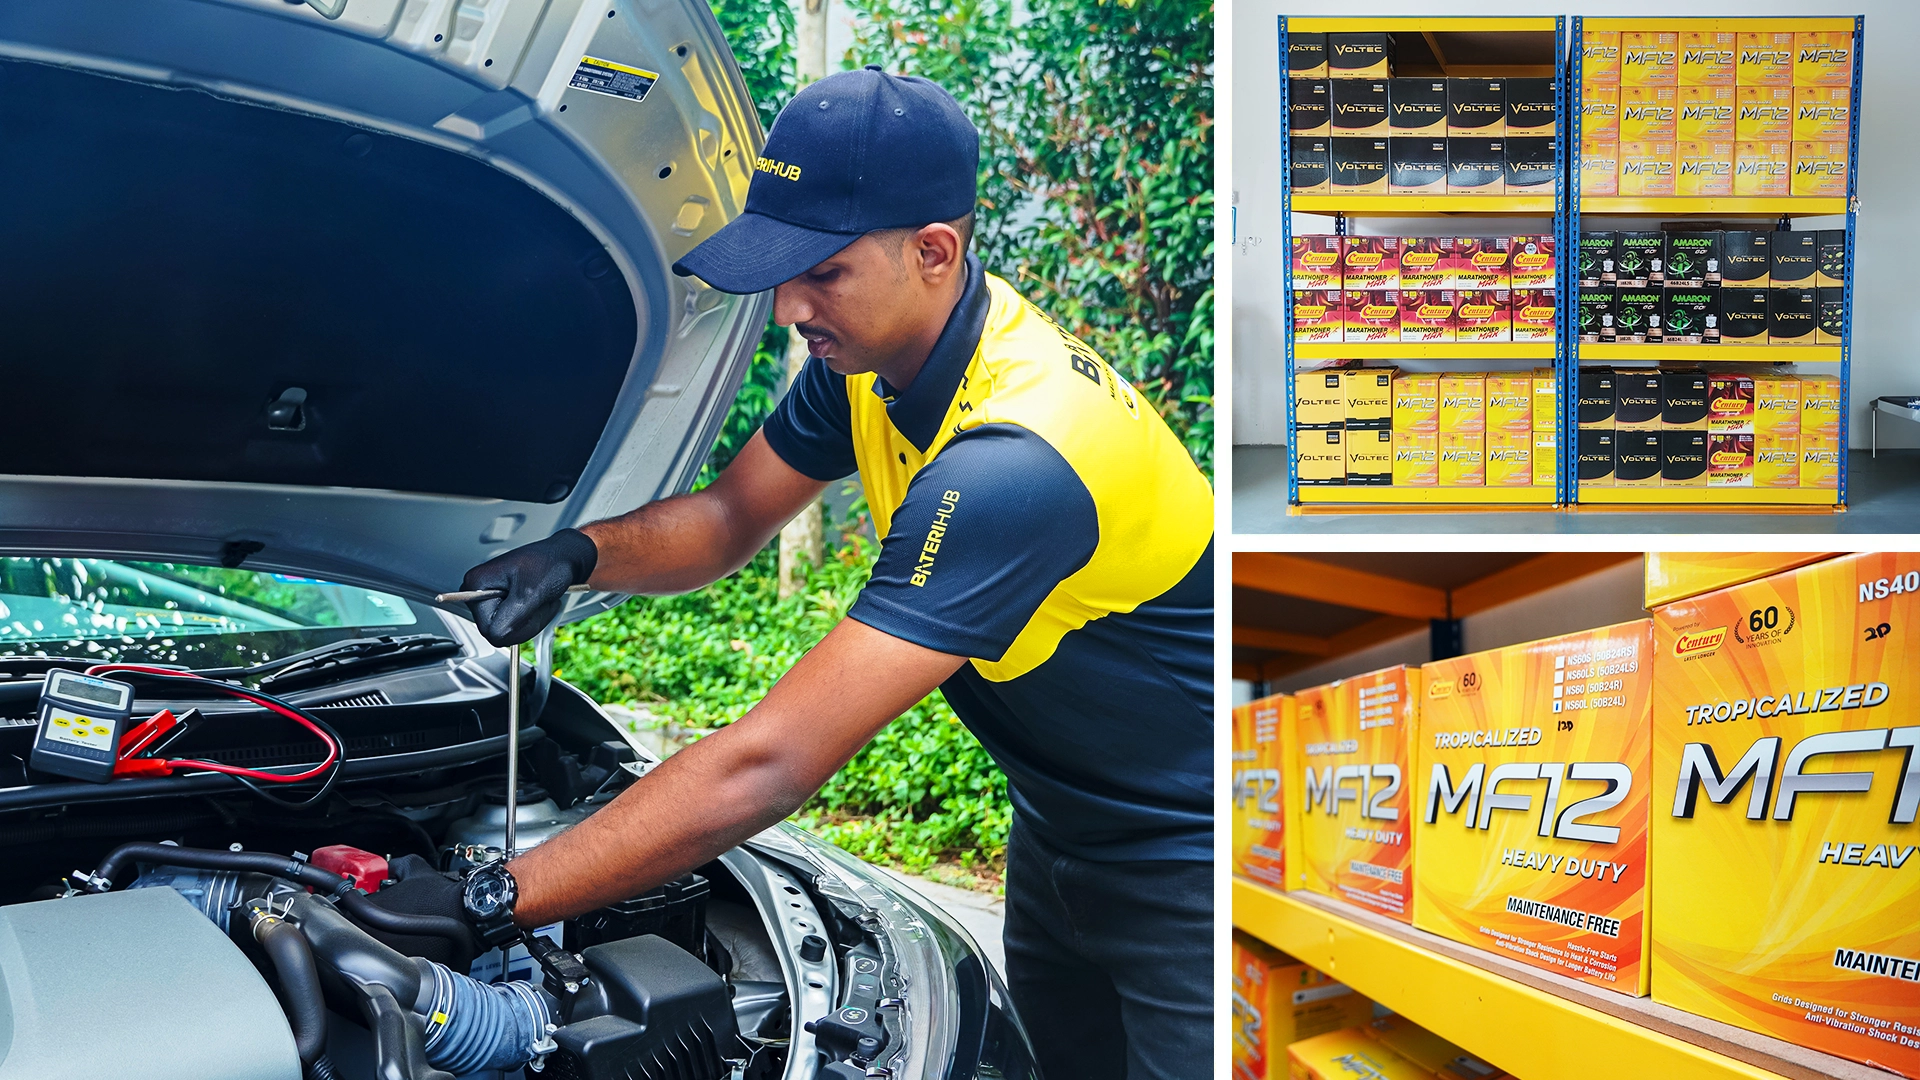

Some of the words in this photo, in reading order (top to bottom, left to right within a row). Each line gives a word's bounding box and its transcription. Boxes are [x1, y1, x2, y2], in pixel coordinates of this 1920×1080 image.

[1334, 44, 1382, 56] VOLTEC
[1582, 46, 1618, 58] MF12
[1624, 51, 1675, 65] MF12
[1683, 51, 1734, 65] MF12
[1740, 51, 1791, 65] MF12
[1798, 50, 1848, 62] MF12
[1289, 104, 1324, 112] VOLTEC
[1336, 103, 1384, 114] VOLTEC
[1393, 103, 1441, 114] VOLTEC
[1453, 103, 1500, 114] VOLTEC
[1582, 104, 1616, 115] MF12
[1624, 107, 1674, 120] MF12
[1682, 106, 1733, 120] MF12
[1740, 106, 1790, 120] MF12
[1798, 107, 1848, 120] MF12
[1336, 162, 1383, 173] VOLTEC
[1394, 162, 1441, 174] VOLTEC
[1452, 162, 1499, 174] VOLTEC
[1623, 162, 1673, 175] MF12
[1680, 162, 1731, 174] MF12
[1736, 162, 1788, 175] MF12
[1796, 162, 1845, 175] MF12
[1623, 238, 1661, 246] AMARON
[1672, 239, 1712, 247] AMARON
[1303, 253, 1335, 263] Century
[1347, 254, 1379, 263] Century
[1404, 254, 1436, 263] Century
[1474, 254, 1505, 263] Century
[1515, 255, 1546, 264] Century
[1728, 256, 1765, 264] VOLTEC
[1776, 256, 1812, 264] VOLTEC
[1307, 279, 1328, 288] MAX
[1366, 279, 1386, 288] MAX
[1422, 279, 1442, 288] MAX
[1477, 279, 1497, 288] MAX
[1621, 294, 1659, 302] AMARON
[1362, 306, 1394, 316] Century
[1419, 306, 1450, 316] Century
[1461, 306, 1491, 316] Century
[1522, 308, 1552, 317] Century
[1726, 312, 1764, 321] VOLTEC
[1775, 313, 1811, 321] VOLTEC
[1309, 331, 1330, 340] MAX
[1366, 331, 1388, 340] MAX
[1422, 331, 1442, 340] MAX
[1478, 331, 1498, 340] MAX
[1348, 399, 1388, 408] VOLTEC
[1397, 398, 1436, 408] MF12
[1443, 398, 1482, 408] MF12
[1490, 397, 1529, 407] MF12
[1621, 398, 1657, 406] VOLTEC
[1667, 399, 1703, 407] VOLTEC
[1713, 400, 1744, 410] Century
[1758, 400, 1798, 410] MF12
[1726, 423, 1743, 431] MAX
[1350, 454, 1389, 462] VOLTEC
[1396, 451, 1435, 461] MF12
[1442, 451, 1481, 462] MF12
[1490, 450, 1529, 461] MF12
[1621, 455, 1657, 463] VOLTEC
[1667, 455, 1702, 463] VOLTEC
[1712, 453, 1743, 463] Century
[1758, 452, 1797, 463] MF12
[910, 490, 960, 587] BATERIHUB
[1859, 571, 1920, 603] NS40
[1749, 606, 1778, 632] 60
[1672, 624, 1694, 632] Powered
[1745, 631, 1769, 643] YEARS
[1770, 629, 1782, 637] OF
[1676, 631, 1724, 654] Century
[1745, 638, 1782, 649] INNOVATION
[1567, 653, 1591, 665] NS60S
[1594, 646, 1635, 663] (50B24RS)
[1698, 652, 1715, 660] LONGER
[1566, 668, 1595, 681] NS60LS
[1597, 662, 1638, 677] (50B24LS)
[1463, 673, 1475, 687] 60
[1566, 684, 1585, 695] NS60
[1586, 680, 1623, 694] (50B24R)
[1565, 699, 1588, 711] NS60L
[1590, 695, 1626, 709] (50B24L)
[1686, 682, 1889, 725] TROPICALIZED
[1435, 727, 1542, 749] TROPICALIZED
[1305, 740, 1359, 756] TROPICALIZED
[1304, 763, 1401, 821] MF12
[1424, 762, 1632, 844] MF12
[1345, 827, 1375, 844] HEAVY
[1375, 830, 1403, 847] DUTY
[1819, 841, 1920, 869] HEAV
[1502, 848, 1564, 874] HEAVY
[1565, 857, 1628, 883] DUTY
[1349, 861, 1387, 879] MAINTENANCE
[1387, 868, 1403, 884] FREE
[1506, 896, 1585, 929] MAINTENANCE
[1586, 914, 1620, 938] FREE
[1479, 926, 1490, 935] Grids
[1491, 929, 1511, 942] Designed
[1518, 936, 1537, 949] Stronger
[1537, 942, 1563, 956] Resistance
[1570, 952, 1583, 962] Heat
[1583, 954, 1588, 964] &
[1589, 957, 1616, 972] Corrosion
[1567, 942, 1599, 955] Hassle-Free
[1600, 949, 1617, 962] Starts
[1495, 939, 1525, 954] Anti-Vibration
[1525, 948, 1539, 959] Shock
[1540, 951, 1557, 964] Design
[1565, 960, 1584, 973] Longer
[1584, 964, 1604, 981] Battery
[1604, 971, 1616, 982] Life
[1772, 992, 1793, 1005] Grids
[1794, 997, 1834, 1015] Designed
[1835, 1007, 1849, 1019] for
[1849, 1011, 1891, 1029] Stronger
[1804, 1012, 1866, 1035] Anti-Vibration
[1867, 1026, 1898, 1043] Shock
